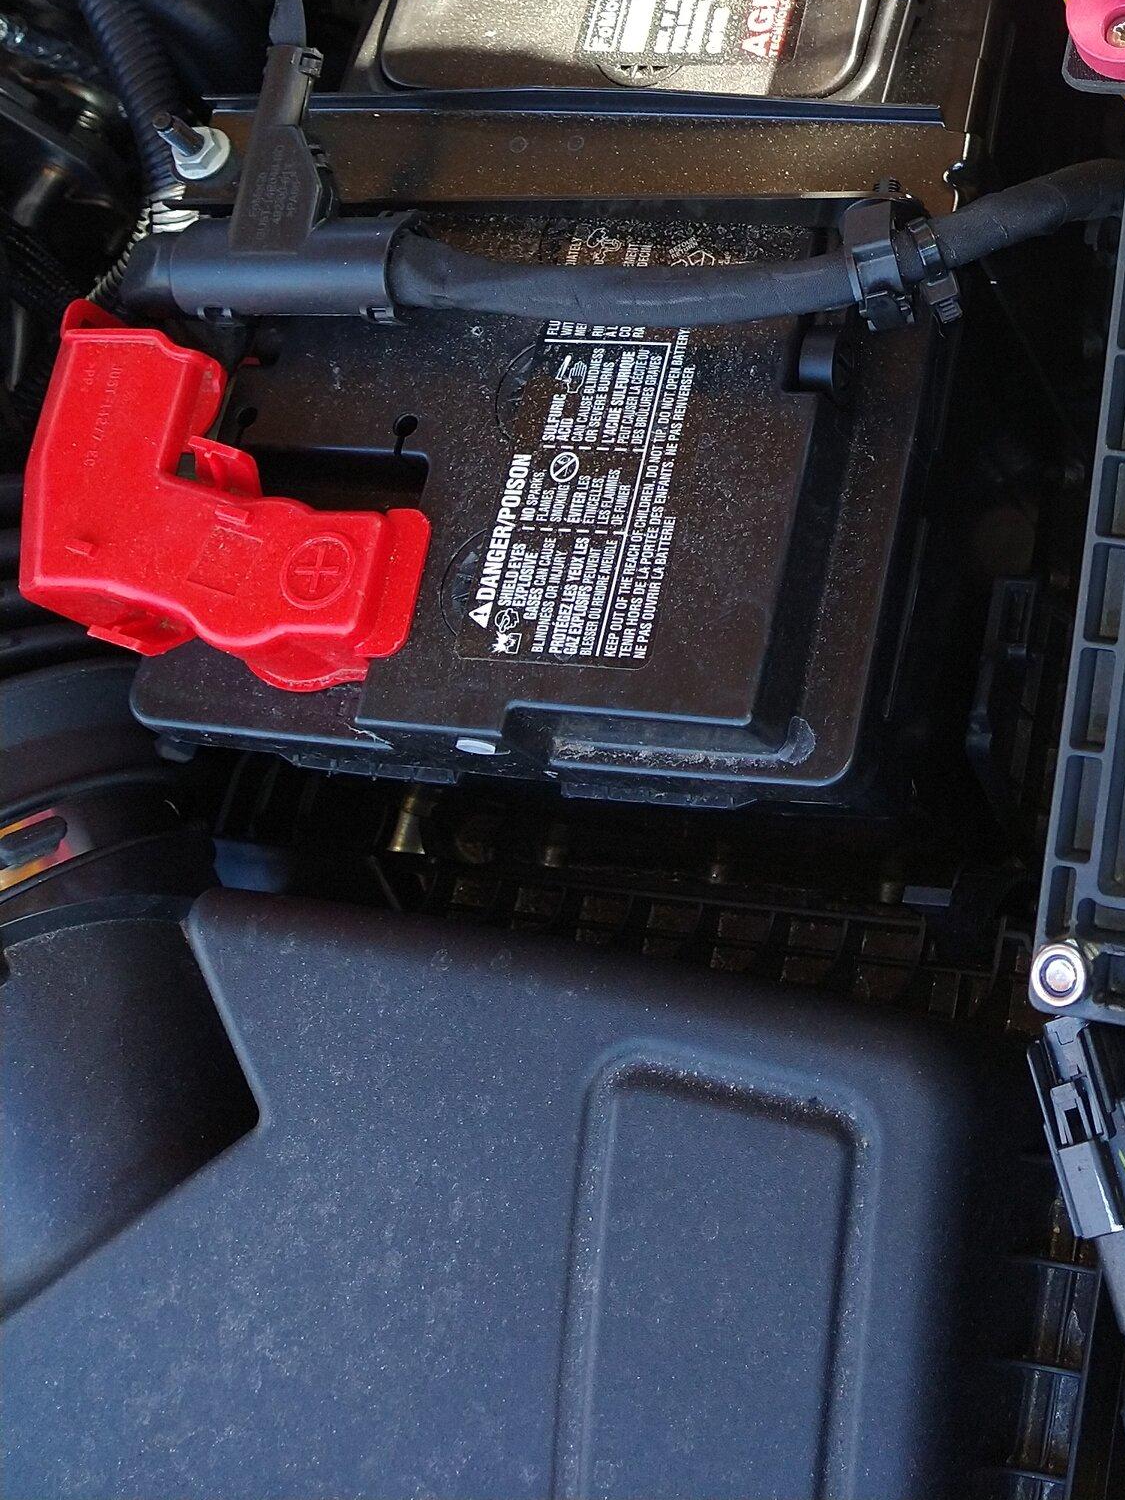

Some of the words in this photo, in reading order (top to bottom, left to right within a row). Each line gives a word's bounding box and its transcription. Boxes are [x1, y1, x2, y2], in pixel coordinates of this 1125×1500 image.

[546, 320, 561, 336] FLU
[636, 348, 650, 358] OU
[582, 347, 605, 393] BLINDNESS
[596, 360, 615, 391] BURNS
[609, 350, 636, 406] SULFURIQUE
[664, 366, 682, 389] OPEN
[628, 384, 642, 394] LA
[660, 391, 676, 409] NOT
[671, 363, 697, 419] RENVERSER.
[541, 393, 566, 440] SULFURIC
[575, 395, 593, 422] CAUSE
[588, 392, 608, 426] SEVERE
[620, 395, 640, 424] CAUSER
[632, 385, 656, 426] BRÛLURES
[657, 410, 672, 424] DO
[555, 417, 574, 440] ACID
[571, 423, 587, 441] CAN
[584, 426, 600, 441] OR
[616, 425, 632, 443] PEUT
[630, 428, 645, 443] DES
[667, 421, 684, 441] PAS
[648, 444, 664, 462] NOT
[663, 442, 679, 455] NE
[645, 464, 660, 477] DO
[652, 457, 676, 504] ENFANTS.
[563, 490, 587, 522] ÉVITER
[576, 474, 591, 490] LES
[613, 483, 632, 512] FUMER
[633, 479, 656, 527] CHILDREN.
[519, 506, 536, 520] NO
[596, 509, 611, 524] LES
[610, 513, 625, 524] DE
[648, 505, 665, 524] DES
[475, 453, 532, 600] DANGER/POISON
[630, 530, 644, 541] OF
[537, 537, 557, 566] CAUSE
[572, 536, 590, 554] LES
[636, 525, 661, 564] PORTÉE
[653, 515, 677, 565] BATTERIE!
[506, 543, 527, 569] EYES
[548, 550, 568, 583] INJURY
[582, 547, 602, 584] PEUVENT
[598, 539, 619, 573] AVEUGLE
[622, 544, 641, 574] REACH
[511, 551, 539, 606] EXPLOSIVE
[532, 567, 549, 586] CAN
[565, 556, 585, 582] YEUX
[635, 566, 651, 579] LA
[650, 566, 666, 579] LA
[497, 570, 520, 605] SHIELD
[544, 585, 559, 598] OR
[560, 583, 579, 601] LES
[591, 574, 610, 605] RENDRE
[618, 576, 634, 594] THE
[632, 581, 647, 595] DE
[522, 587, 544, 619] GASES
[567, 584, 593, 633] EXPLOSIFS
[614, 597, 629, 609] OF
[625, 596, 644, 625] HORS
[641, 581, 663, 620] OUVRIR
[587, 606, 602, 619] OU
[609, 611, 626, 630] OUT
[530, 600, 555, 652] BLINDNESS
[545, 602, 574, 653] PROTÉGEZ
[579, 620, 599, 654] BLESSER
[636, 621, 653, 642] PAS
[562, 634, 581, 654] GAZ
[603, 633, 620, 656] KEEP
[617, 626, 637, 657] TENIR
[632, 644, 648, 659] NE
